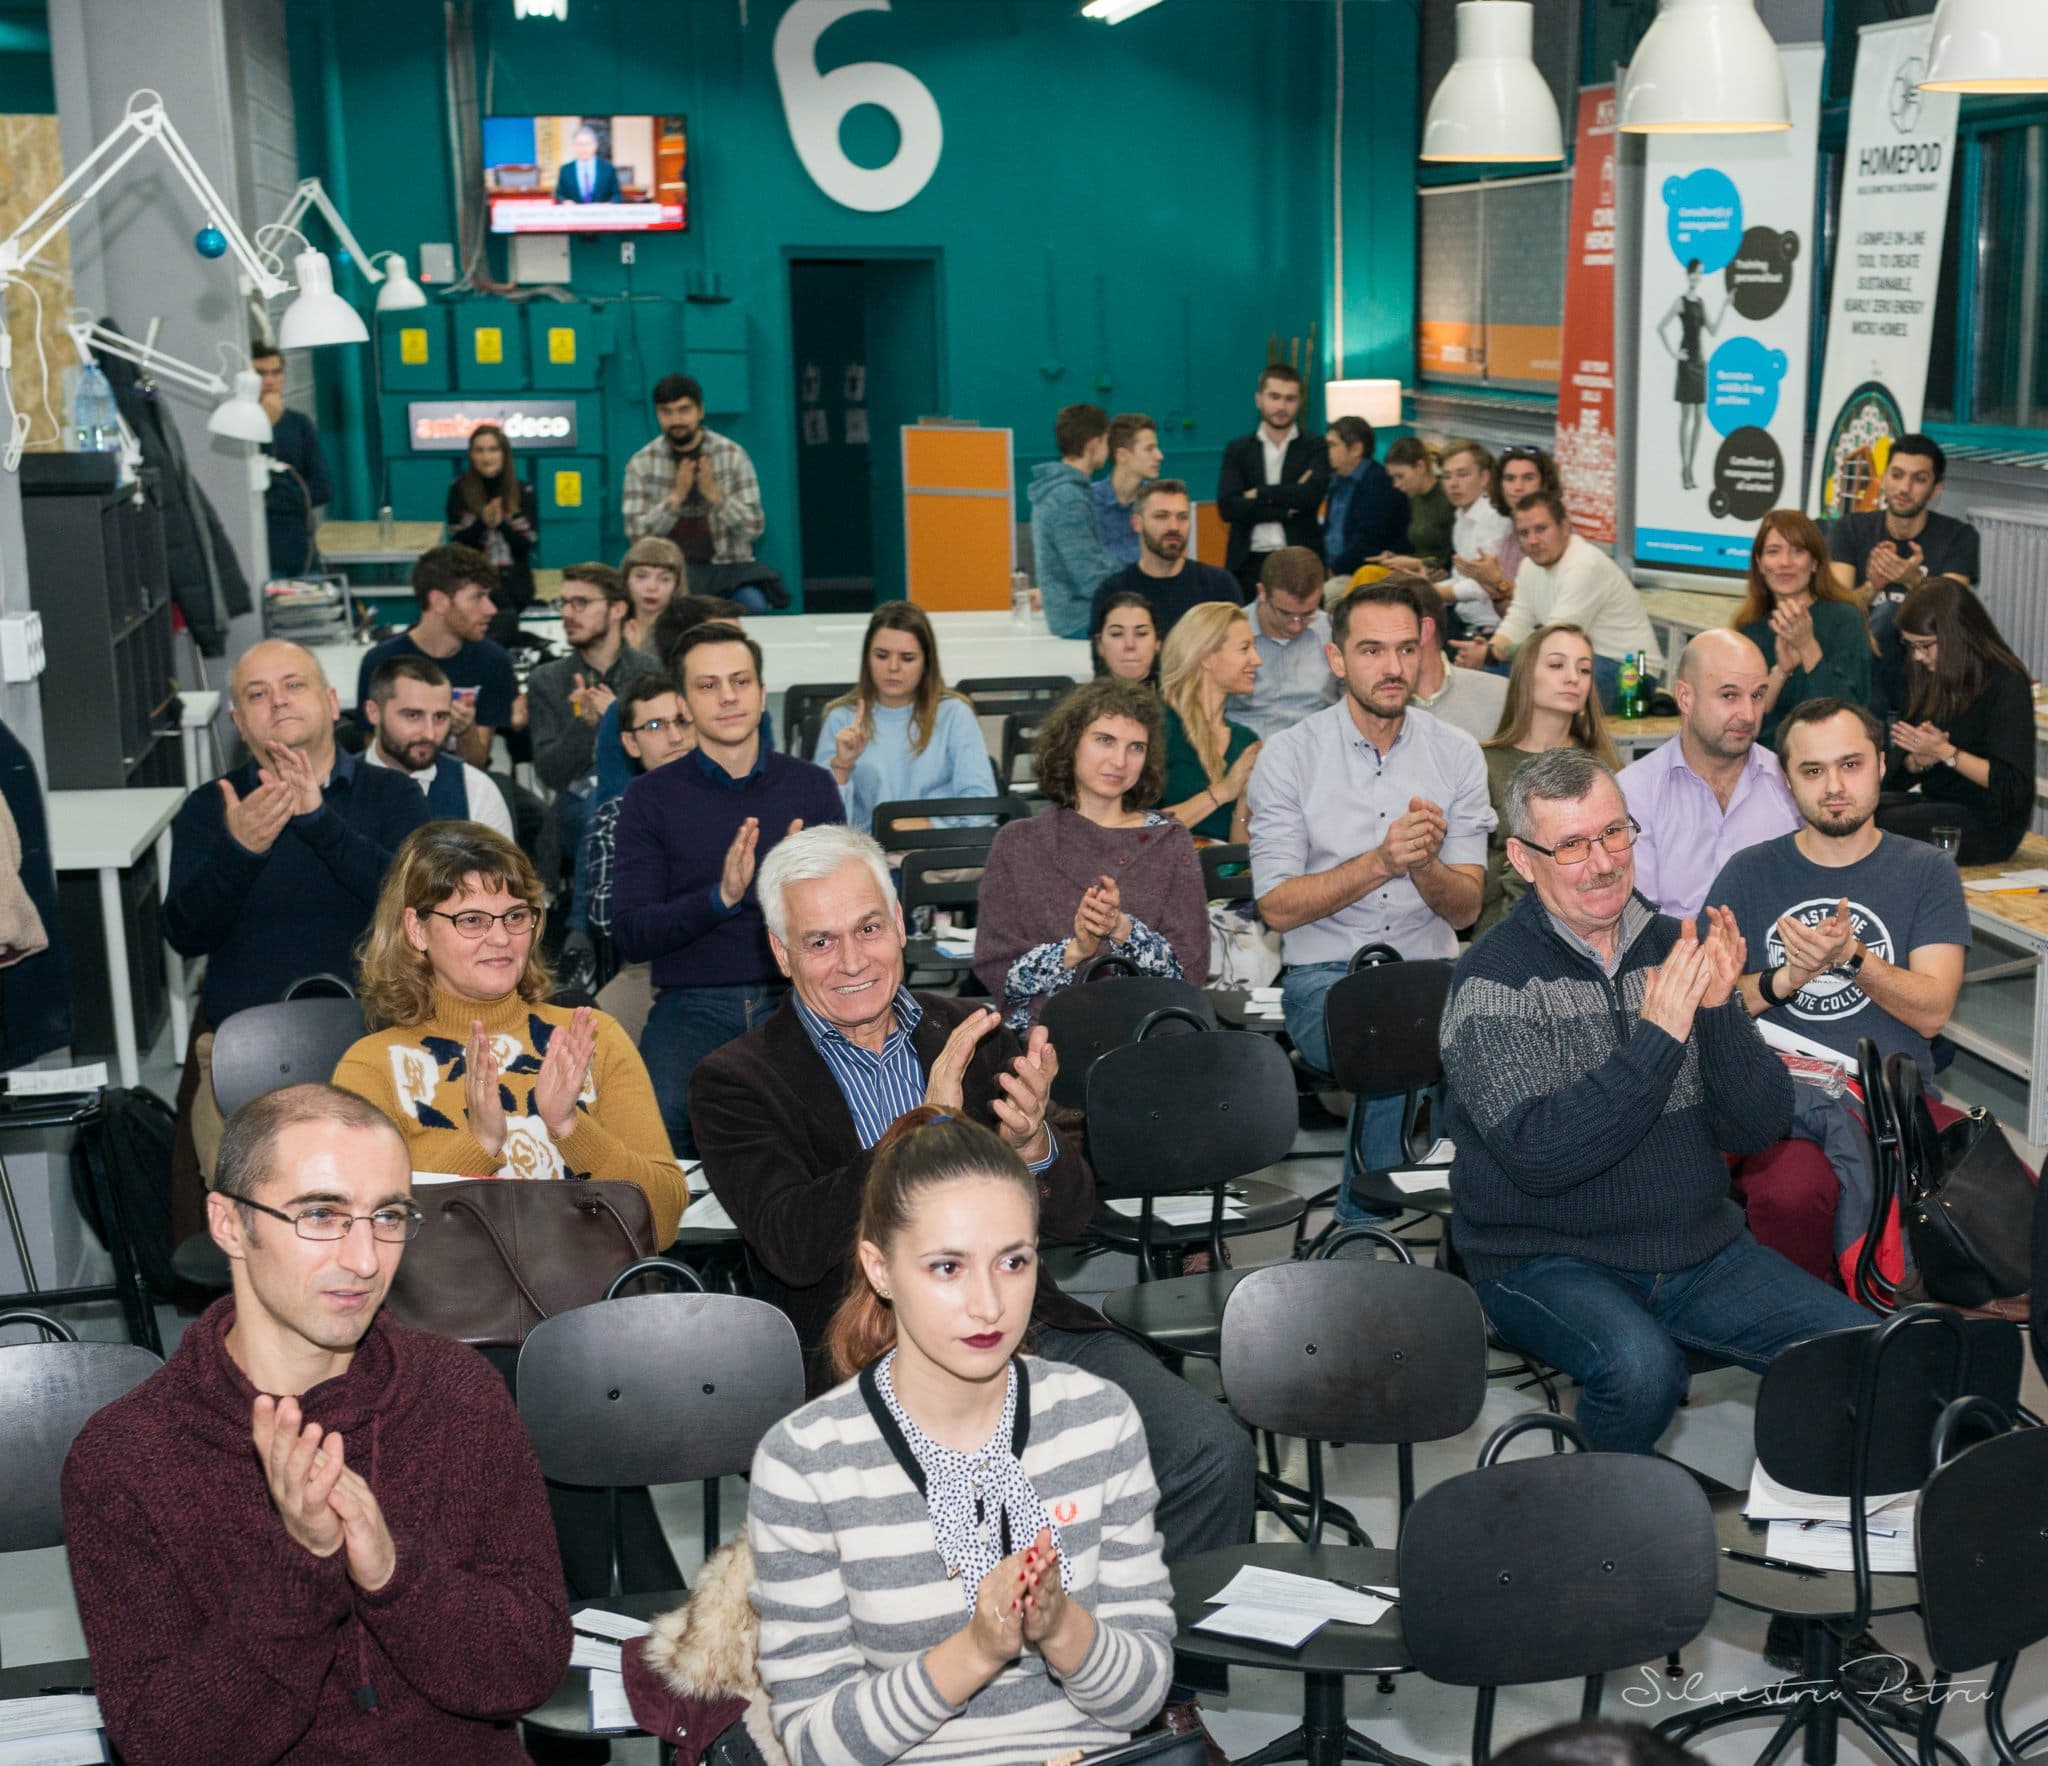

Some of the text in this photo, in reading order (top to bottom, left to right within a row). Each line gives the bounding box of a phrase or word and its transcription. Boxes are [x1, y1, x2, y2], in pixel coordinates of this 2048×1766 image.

[773, 0, 943, 213] 6
[1859, 142, 1942, 176] HOMEPOD
[1800, 908, 1829, 926] AST
[1795, 986, 1864, 1012] ATE COLLE
